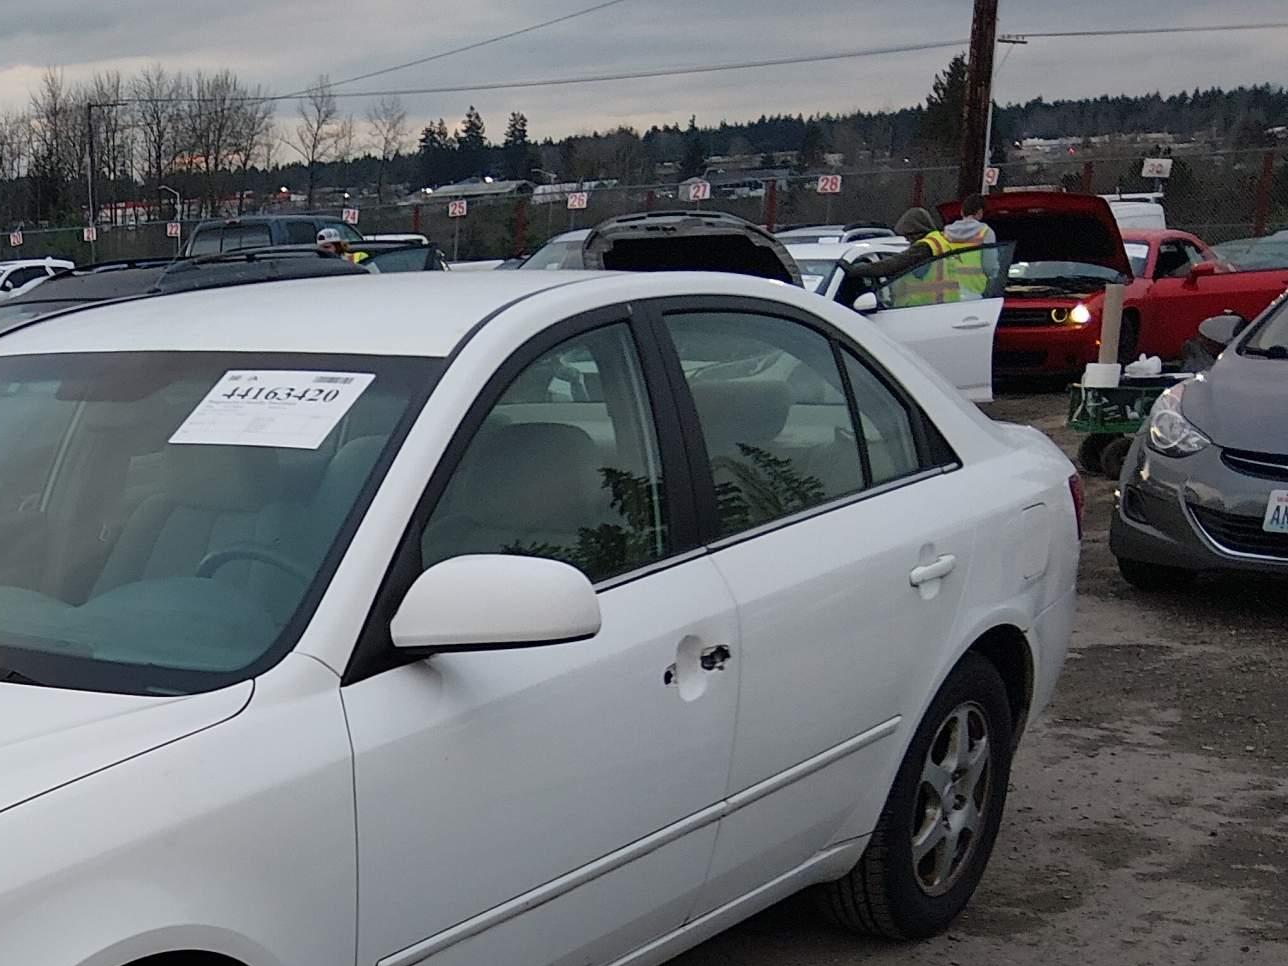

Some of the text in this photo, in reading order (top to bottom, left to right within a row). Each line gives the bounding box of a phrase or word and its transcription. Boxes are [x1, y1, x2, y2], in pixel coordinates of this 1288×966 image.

[819, 175, 839, 192] 28
[693, 184, 708, 199] 27
[570, 194, 585, 207] 26
[344, 210, 356, 222] 24
[450, 202, 464, 216] 25
[168, 223, 179, 236] 22
[221, 386, 340, 403] 44163420
